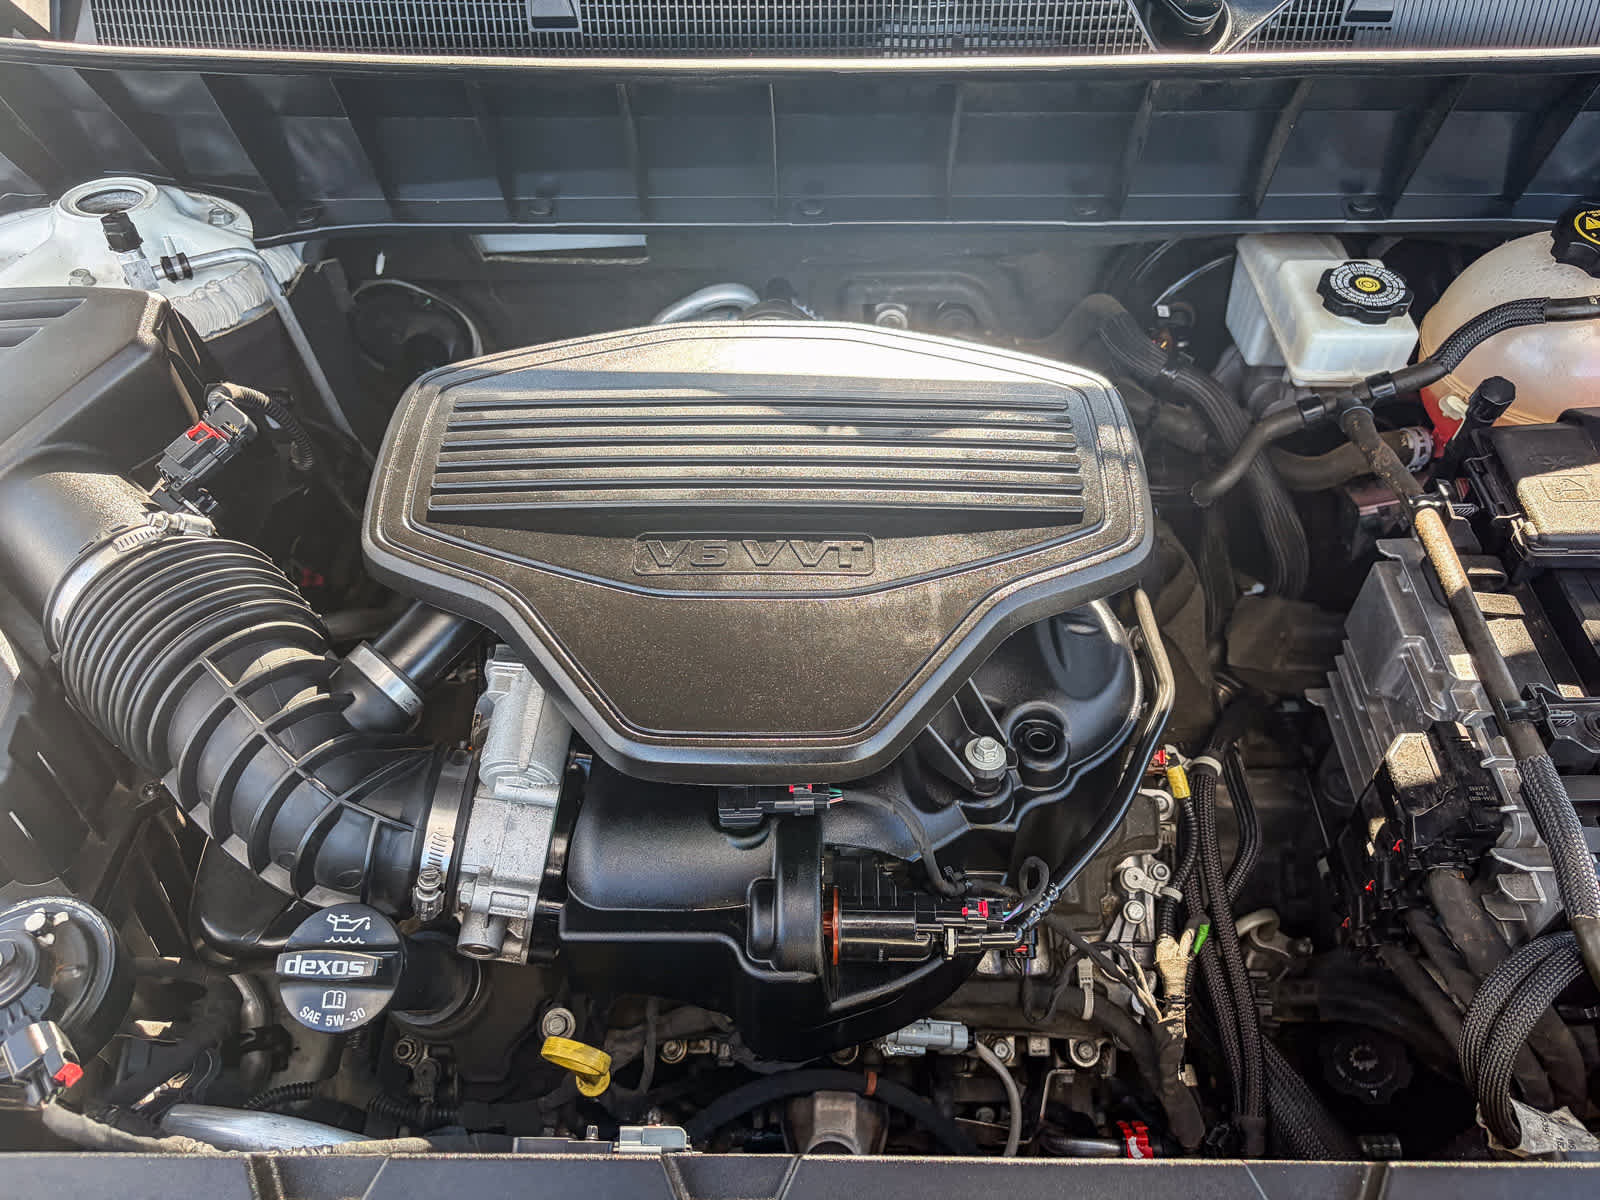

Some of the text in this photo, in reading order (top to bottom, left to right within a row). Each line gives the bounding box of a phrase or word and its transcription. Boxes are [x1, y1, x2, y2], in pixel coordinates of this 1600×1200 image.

[644, 539, 866, 568] V6 VVT
[284, 955, 365, 976] dexos
[300, 1006, 366, 1027] SAE 5W-30
